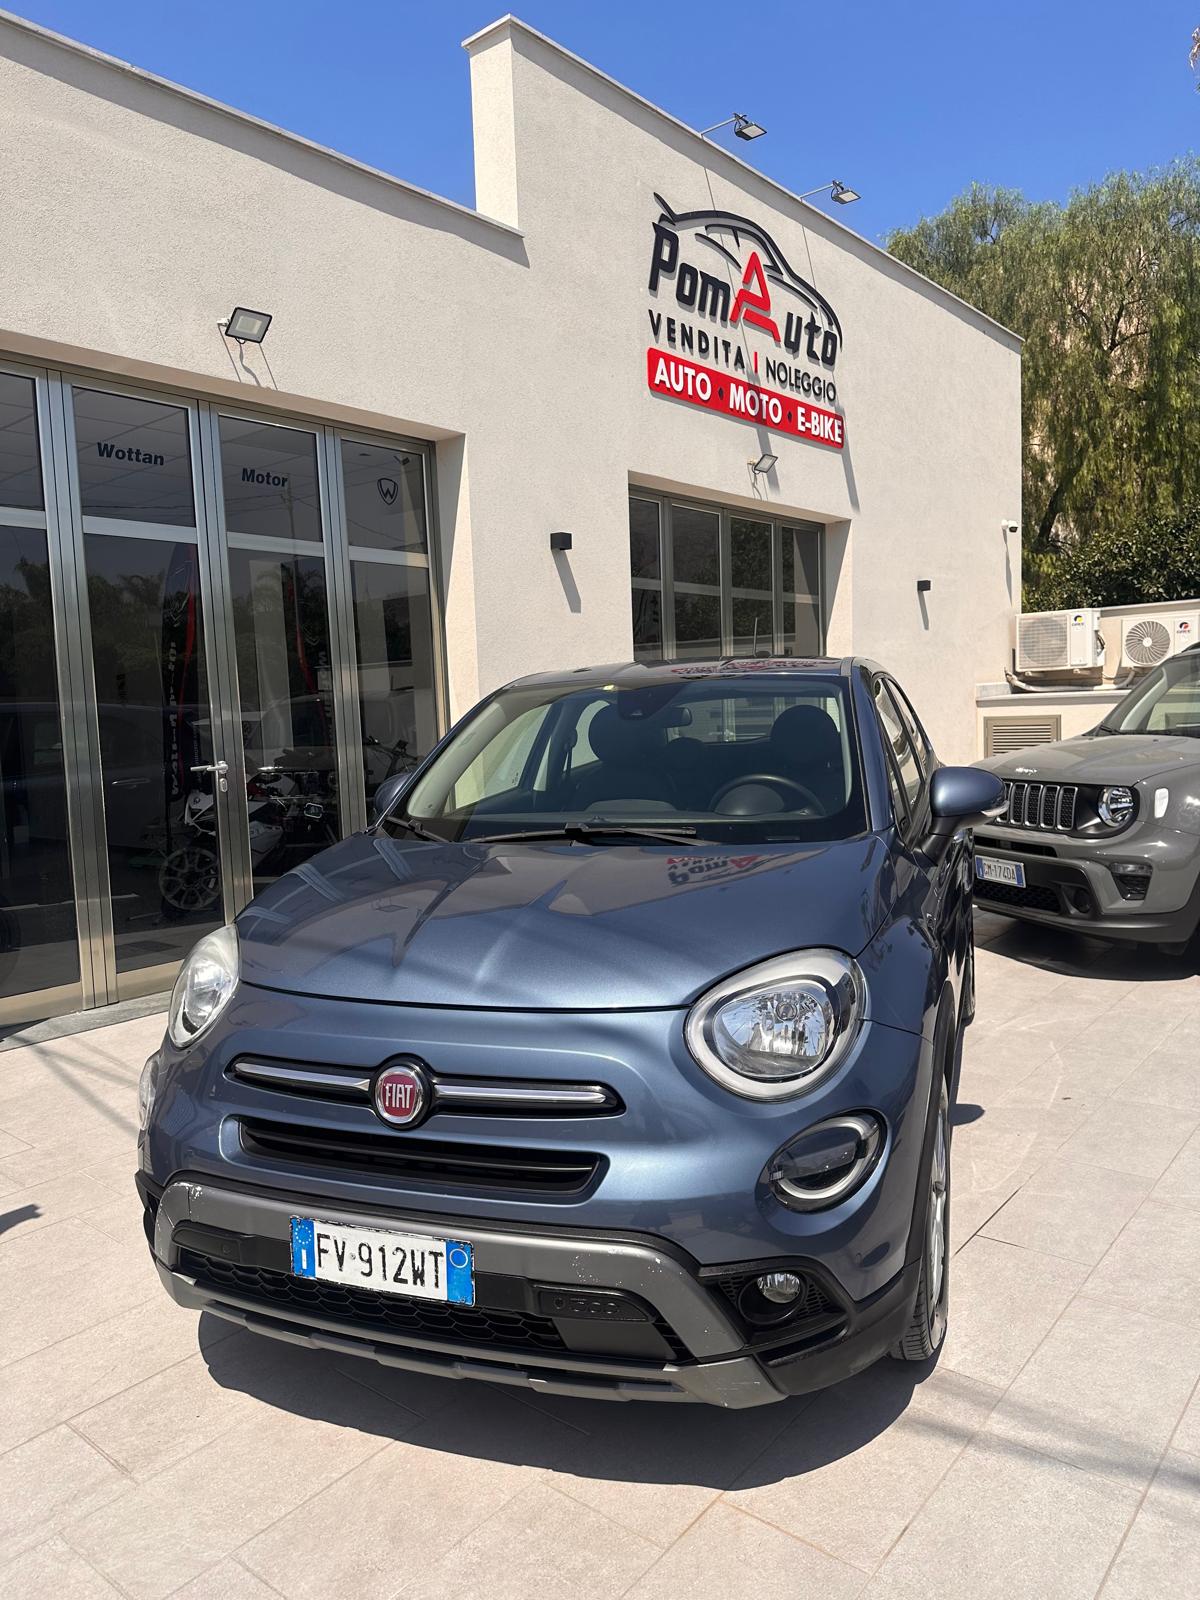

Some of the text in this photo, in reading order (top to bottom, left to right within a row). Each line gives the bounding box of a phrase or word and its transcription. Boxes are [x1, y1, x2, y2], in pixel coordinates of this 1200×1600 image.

[648, 309, 837, 402] VENDITA NOLEGGIO
[654, 357, 843, 443] AUTO MOTO E-BIKE
[97, 441, 289, 489] Wottan Motor
[384, 1082, 413, 1109] FIAT
